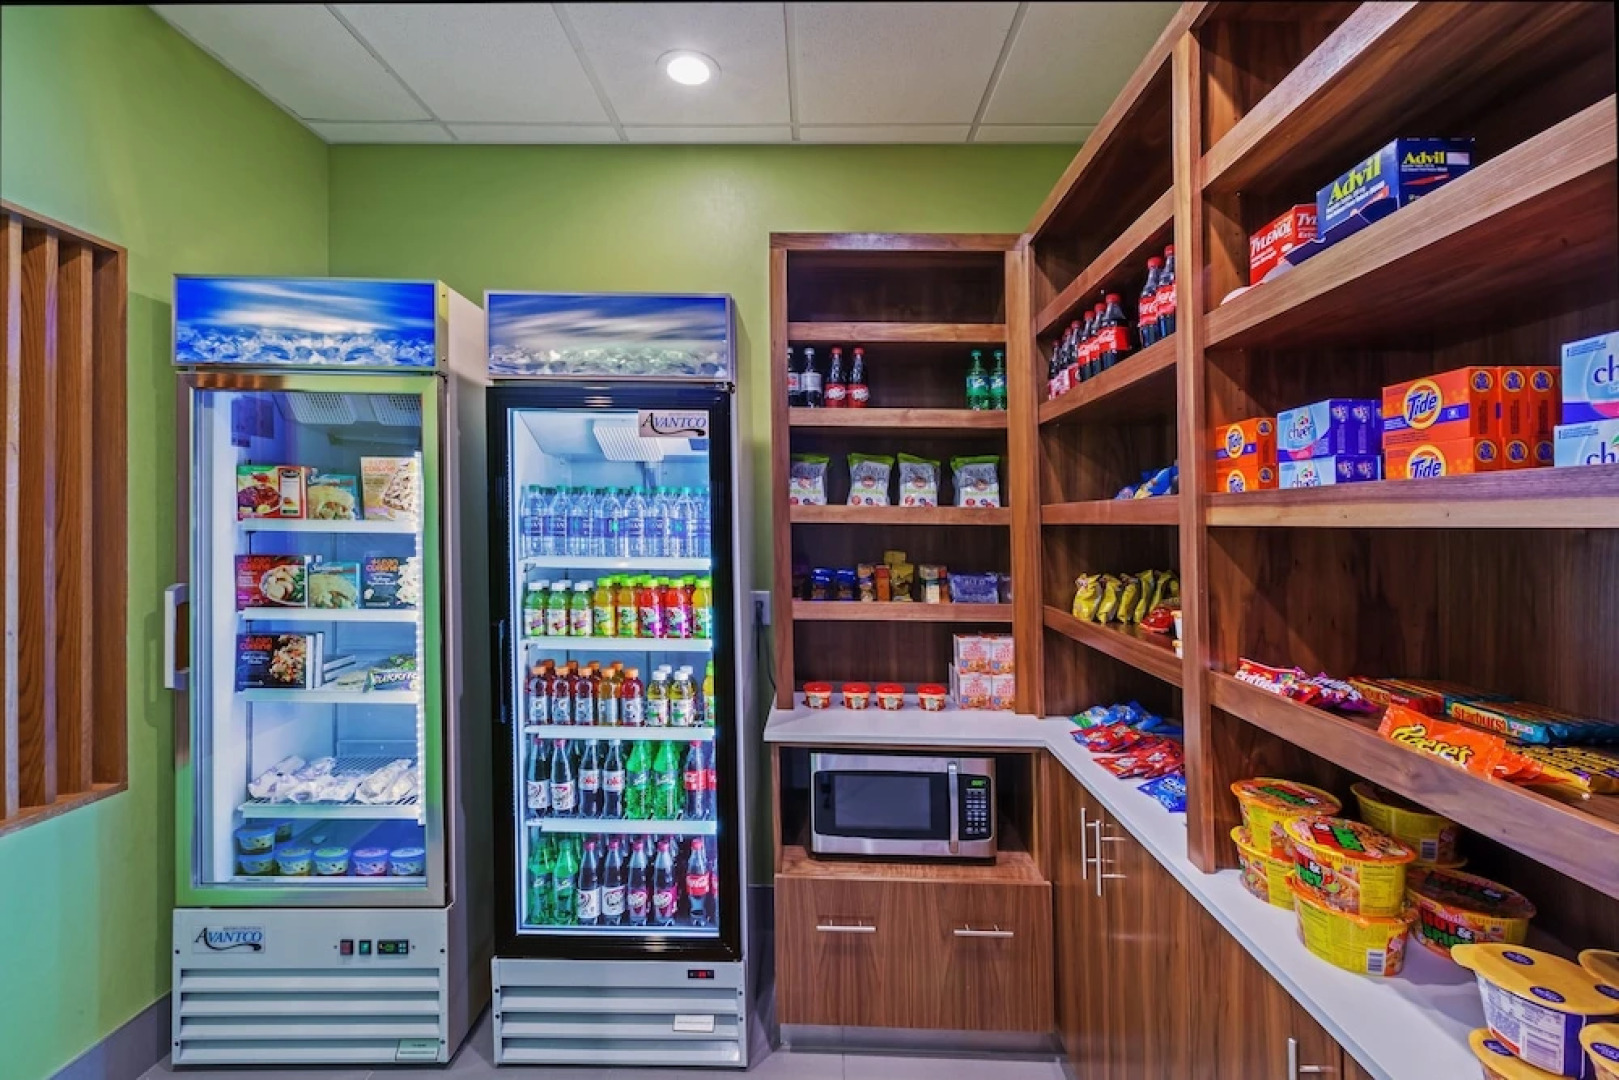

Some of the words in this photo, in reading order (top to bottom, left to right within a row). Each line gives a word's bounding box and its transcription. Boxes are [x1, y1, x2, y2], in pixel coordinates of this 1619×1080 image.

[1403, 151, 1446, 165] Advil
[1328, 153, 1382, 206] Advil
[1250, 219, 1292, 258] TYLENOL
[1406, 393, 1438, 422] Tide
[641, 412, 707, 437] AVANTCO
[1288, 422, 1314, 441] cheer
[1410, 459, 1442, 479] Tide
[1388, 723, 1475, 769] Reese's
[194, 927, 263, 951] AVANTCO
